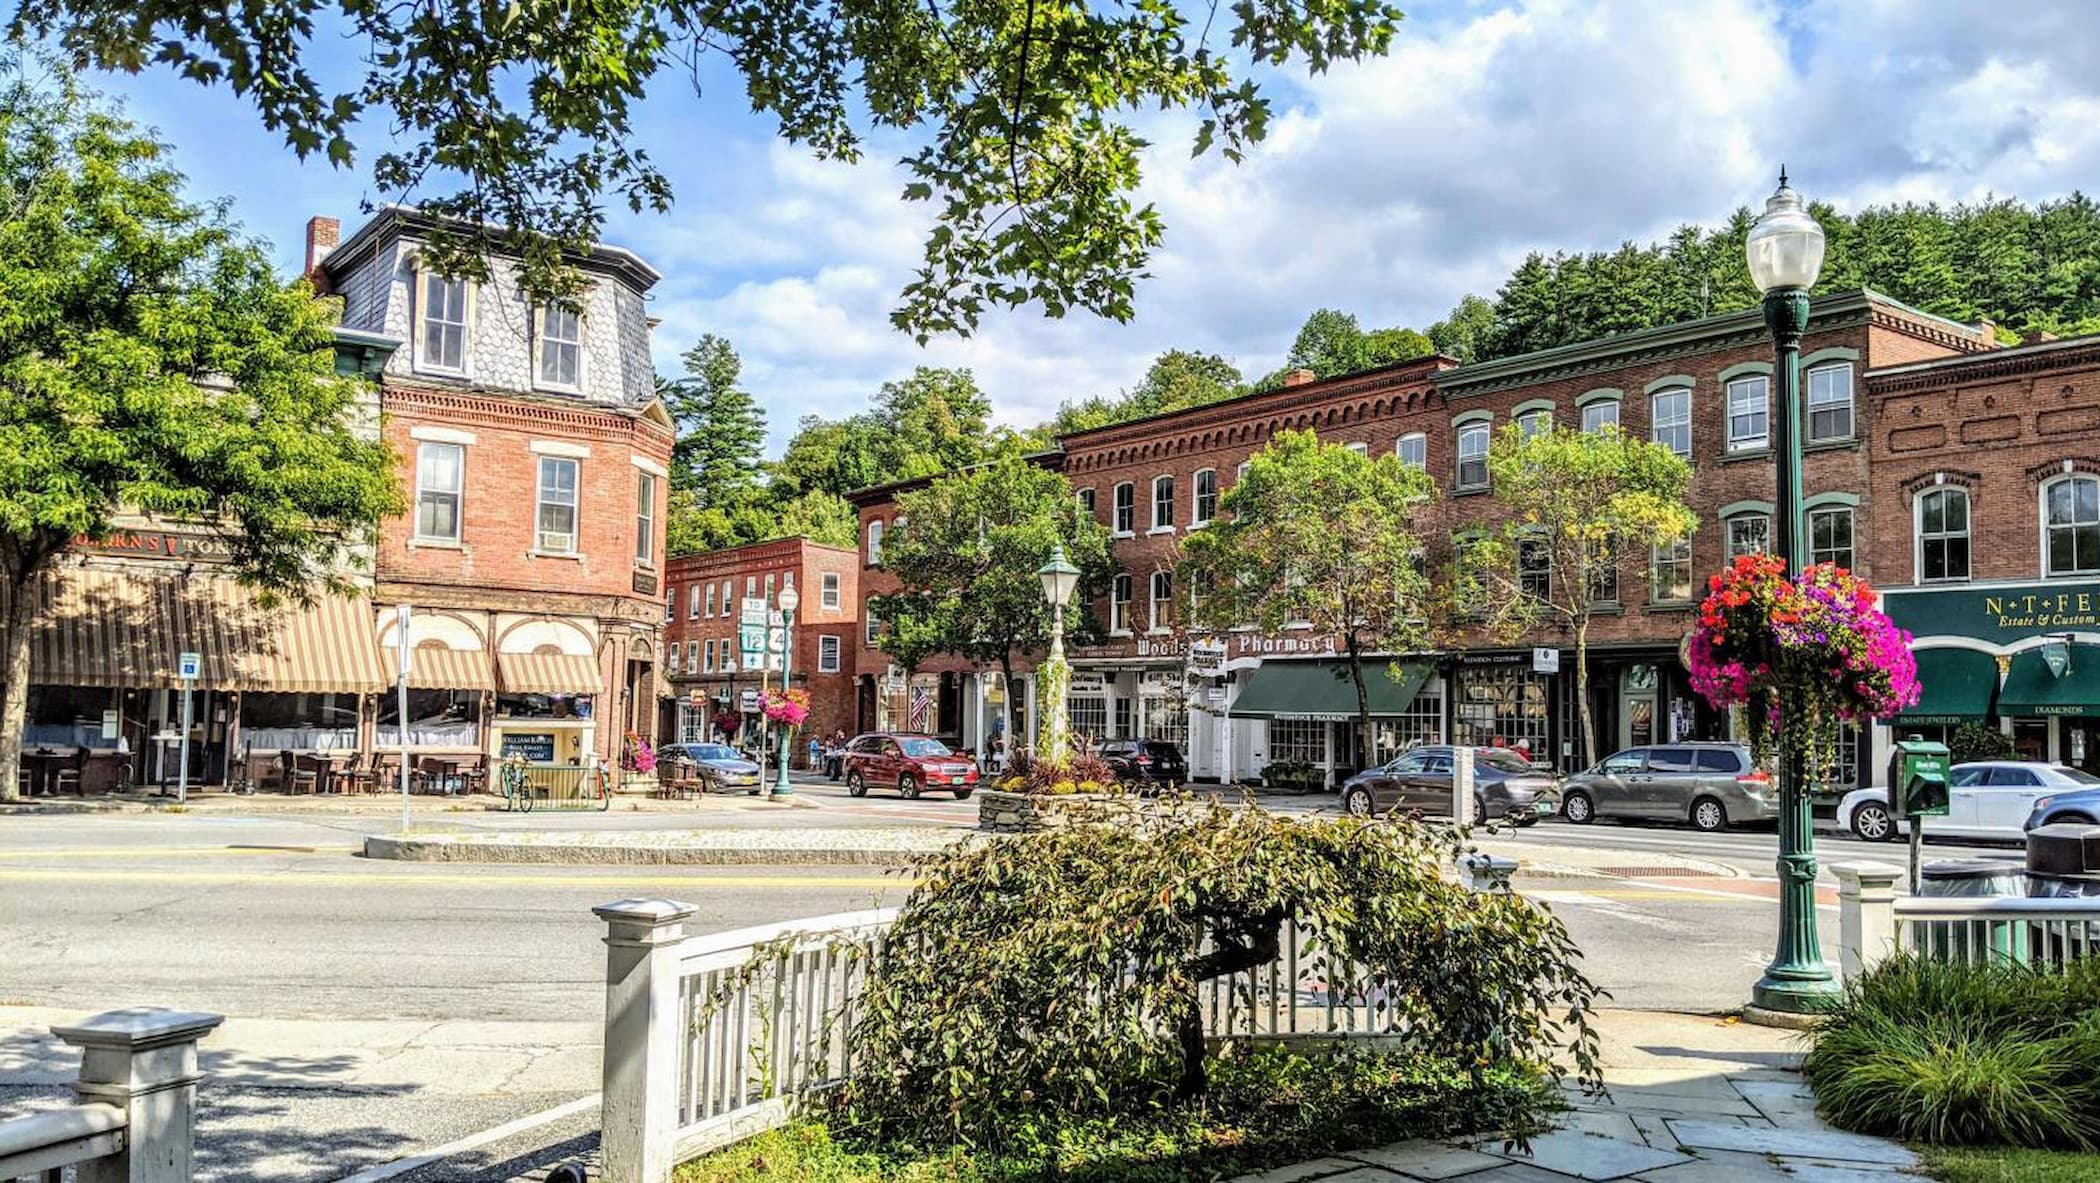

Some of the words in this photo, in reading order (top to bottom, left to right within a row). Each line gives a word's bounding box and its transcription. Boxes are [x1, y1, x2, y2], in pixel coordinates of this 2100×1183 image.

[1999, 615, 2033, 627] Estate
[2037, 614, 2049, 626] &
[2052, 613, 2095, 625] Custom
[746, 633, 761, 649] 12
[774, 633, 785, 646] 4
[1239, 634, 1335, 655] Pharmacy
[2034, 705, 2084, 714] DIAMONDS
